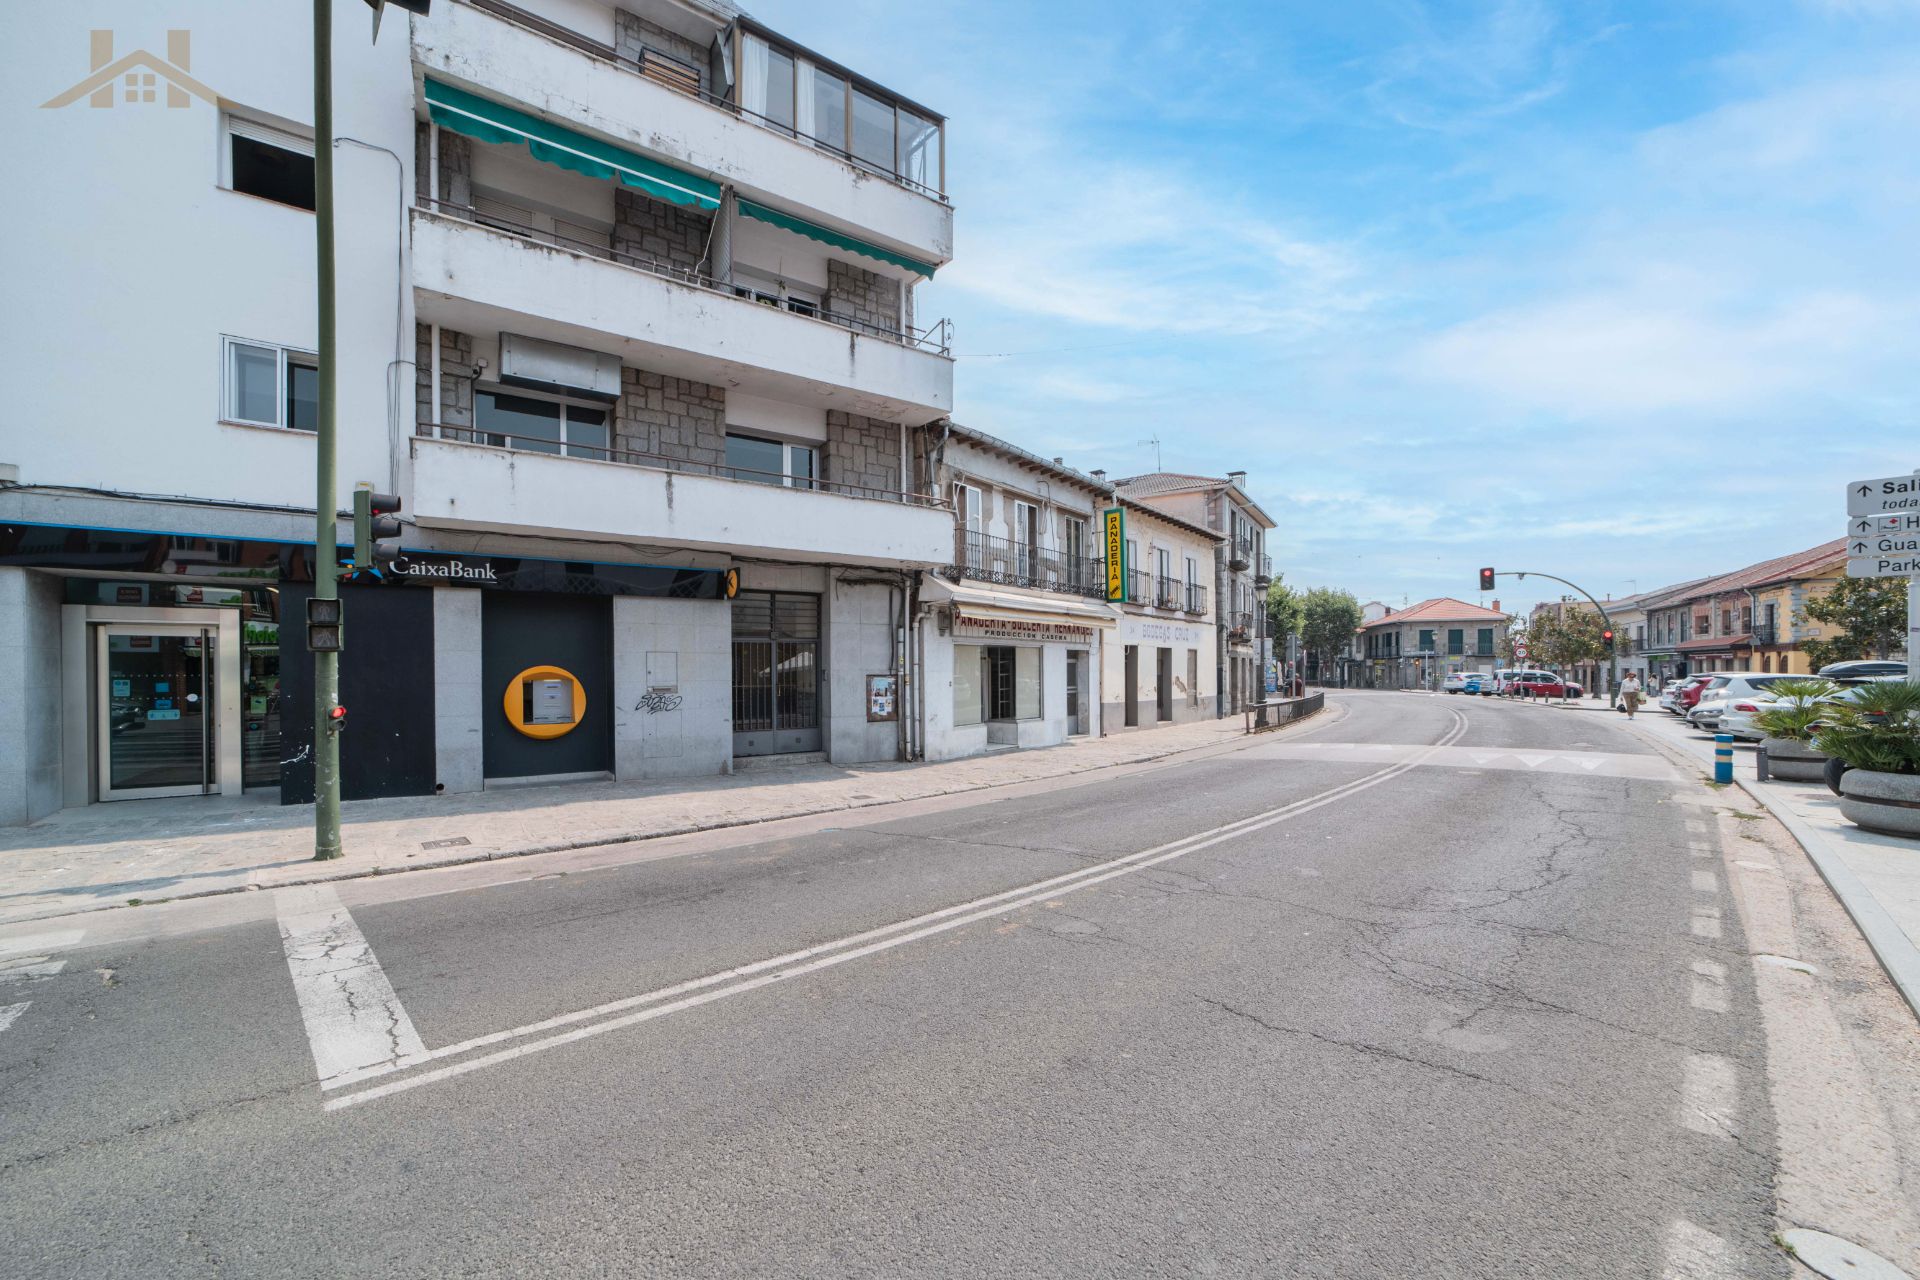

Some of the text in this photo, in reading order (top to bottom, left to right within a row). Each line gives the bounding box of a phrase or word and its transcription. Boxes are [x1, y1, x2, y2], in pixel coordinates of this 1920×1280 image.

[1882, 498, 1920, 510] toda
[1110, 516, 1119, 580] PANADERIA
[1878, 539, 1918, 552] Gua
[389, 556, 498, 580] CaixaBank
[1878, 558, 1920, 573] Park
